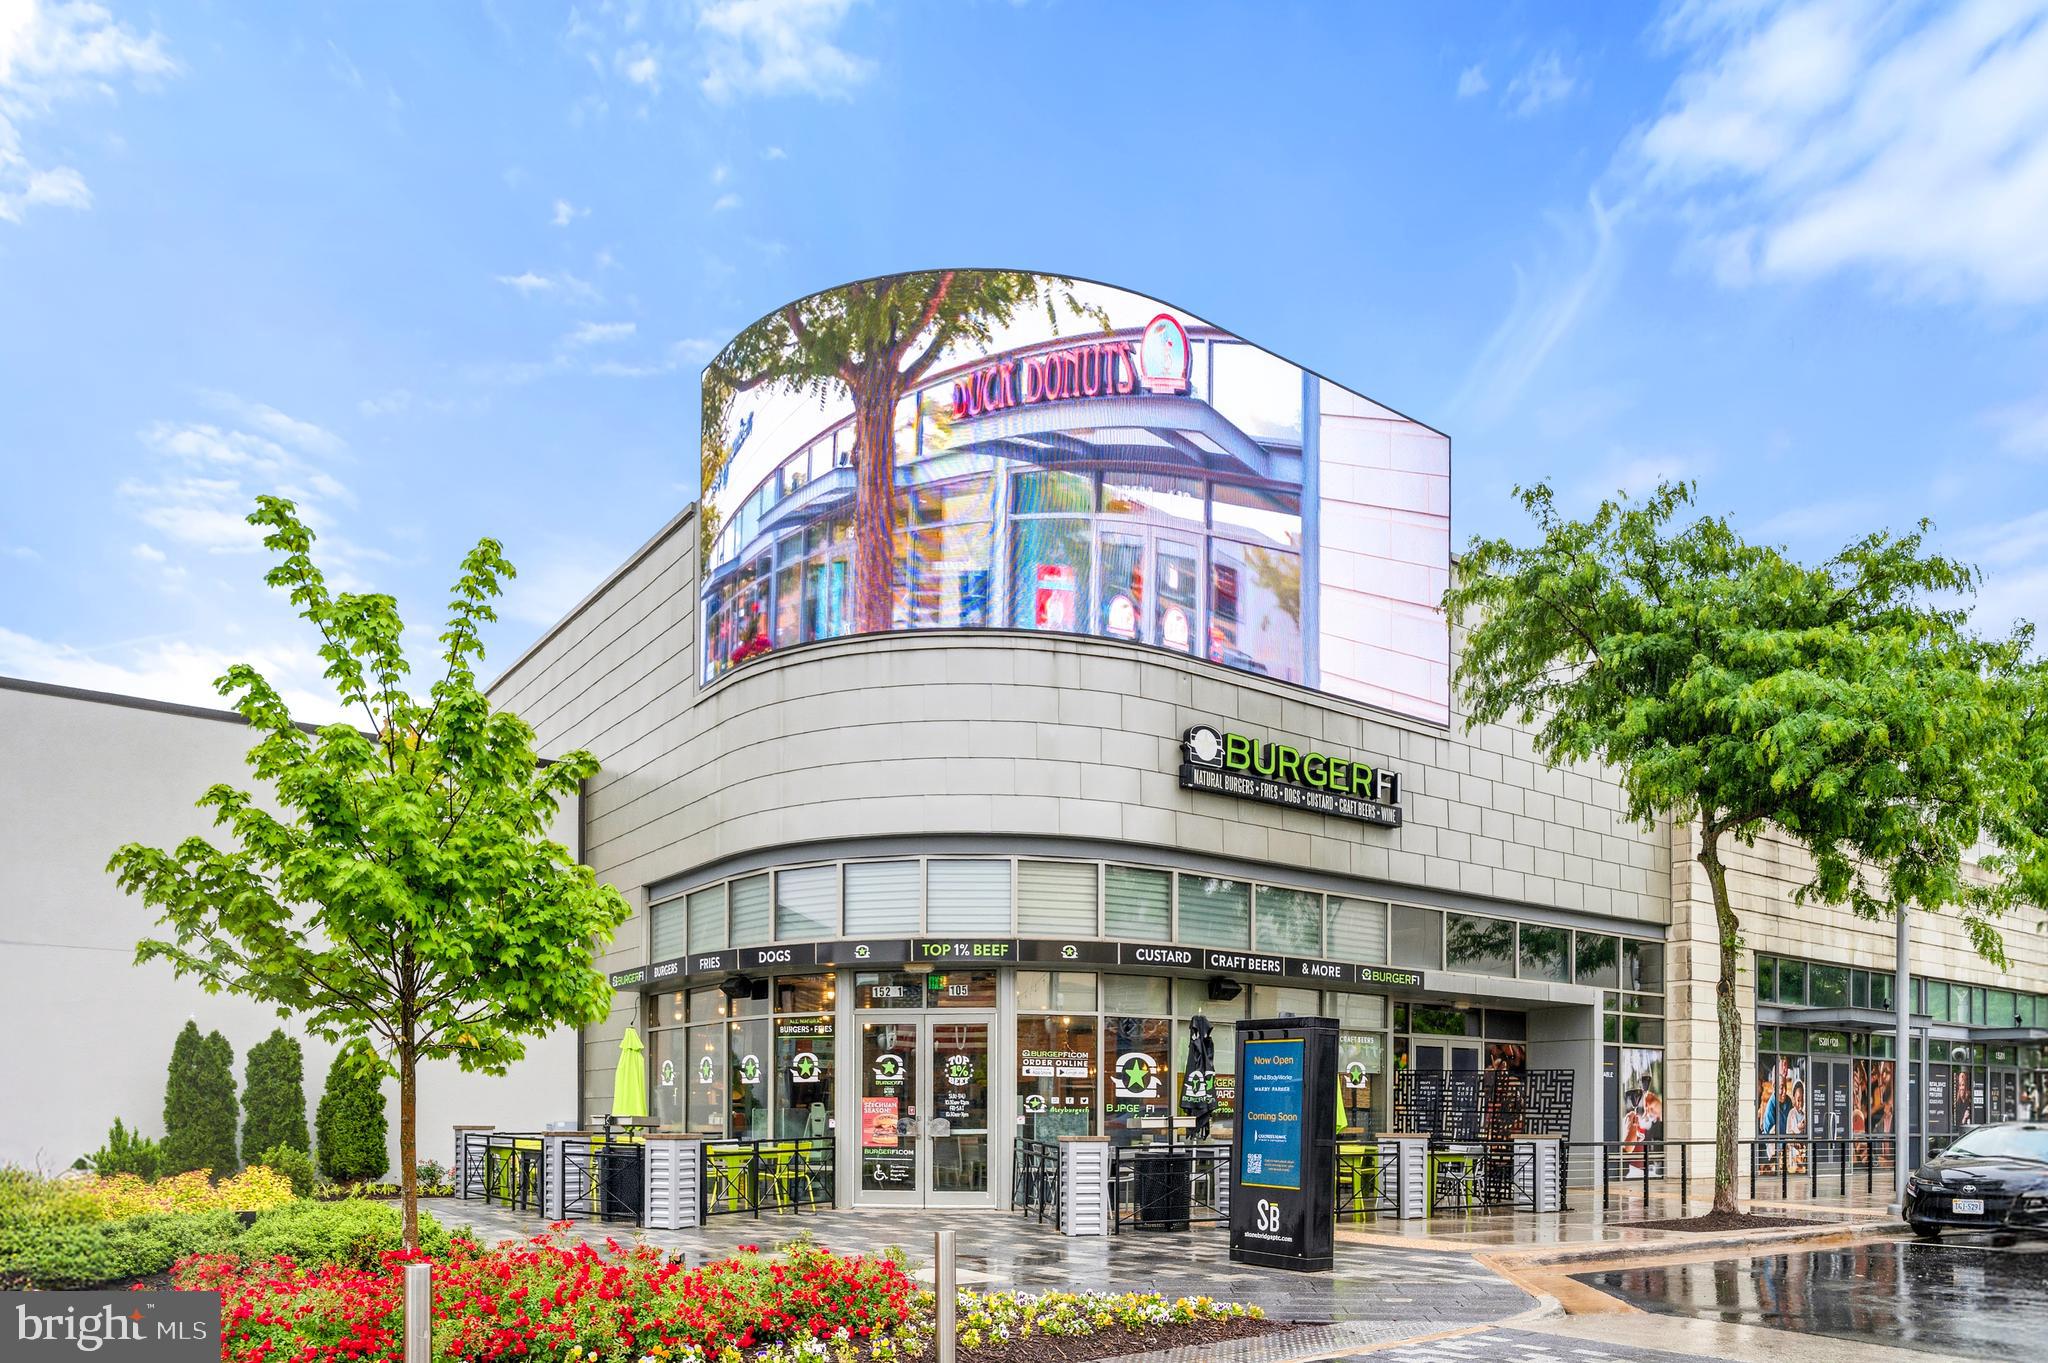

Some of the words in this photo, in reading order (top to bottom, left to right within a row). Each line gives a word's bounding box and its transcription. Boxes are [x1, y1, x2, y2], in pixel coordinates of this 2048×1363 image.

[952, 360, 1016, 419] DUCK
[1024, 341, 1136, 404] DONUTS
[1226, 732, 1402, 804] BURGERFI
[1193, 768, 1223, 789] NATURAL
[1225, 775, 1255, 795] BURGERS
[1260, 782, 1278, 800] FRIES
[1284, 787, 1301, 804] DOGS
[1306, 792, 1334, 811] CUSTARD
[1339, 798, 1357, 815] CRAFT
[1358, 802, 1376, 819] BEERS
[1381, 806, 1396, 823] WINE
[758, 949, 791, 964] DOGS
[922, 944, 951, 957] TOP
[953, 943, 970, 957] 1%
[973, 943, 1009, 957] BEEF
[1135, 948, 1192, 964] CUSTARD
[654, 962, 678, 978] BURGERS
[699, 956, 721, 970] FRIES
[1211, 954, 1246, 969] CRAFT
[1249, 958, 1281, 972] BEERS
[1301, 963, 1309, 975] &
[1311, 964, 1341, 978] MORE
[617, 970, 645, 986] BURGERFI
[1372, 971, 1420, 986] BURGERFI
[950, 985, 968, 996] 105
[780, 1025, 810, 1034] BURGERS
[948, 1054, 970, 1065] TOP
[1254, 1056, 1271, 1065] Now
[1273, 1055, 1294, 1066] Open
[950, 1065, 969, 1077] 1%
[948, 1077, 970, 1086] BEEF
[1248, 1111, 1277, 1122] Coming
[1278, 1112, 1298, 1121] Soon
[1257, 1199, 1280, 1232] SB
